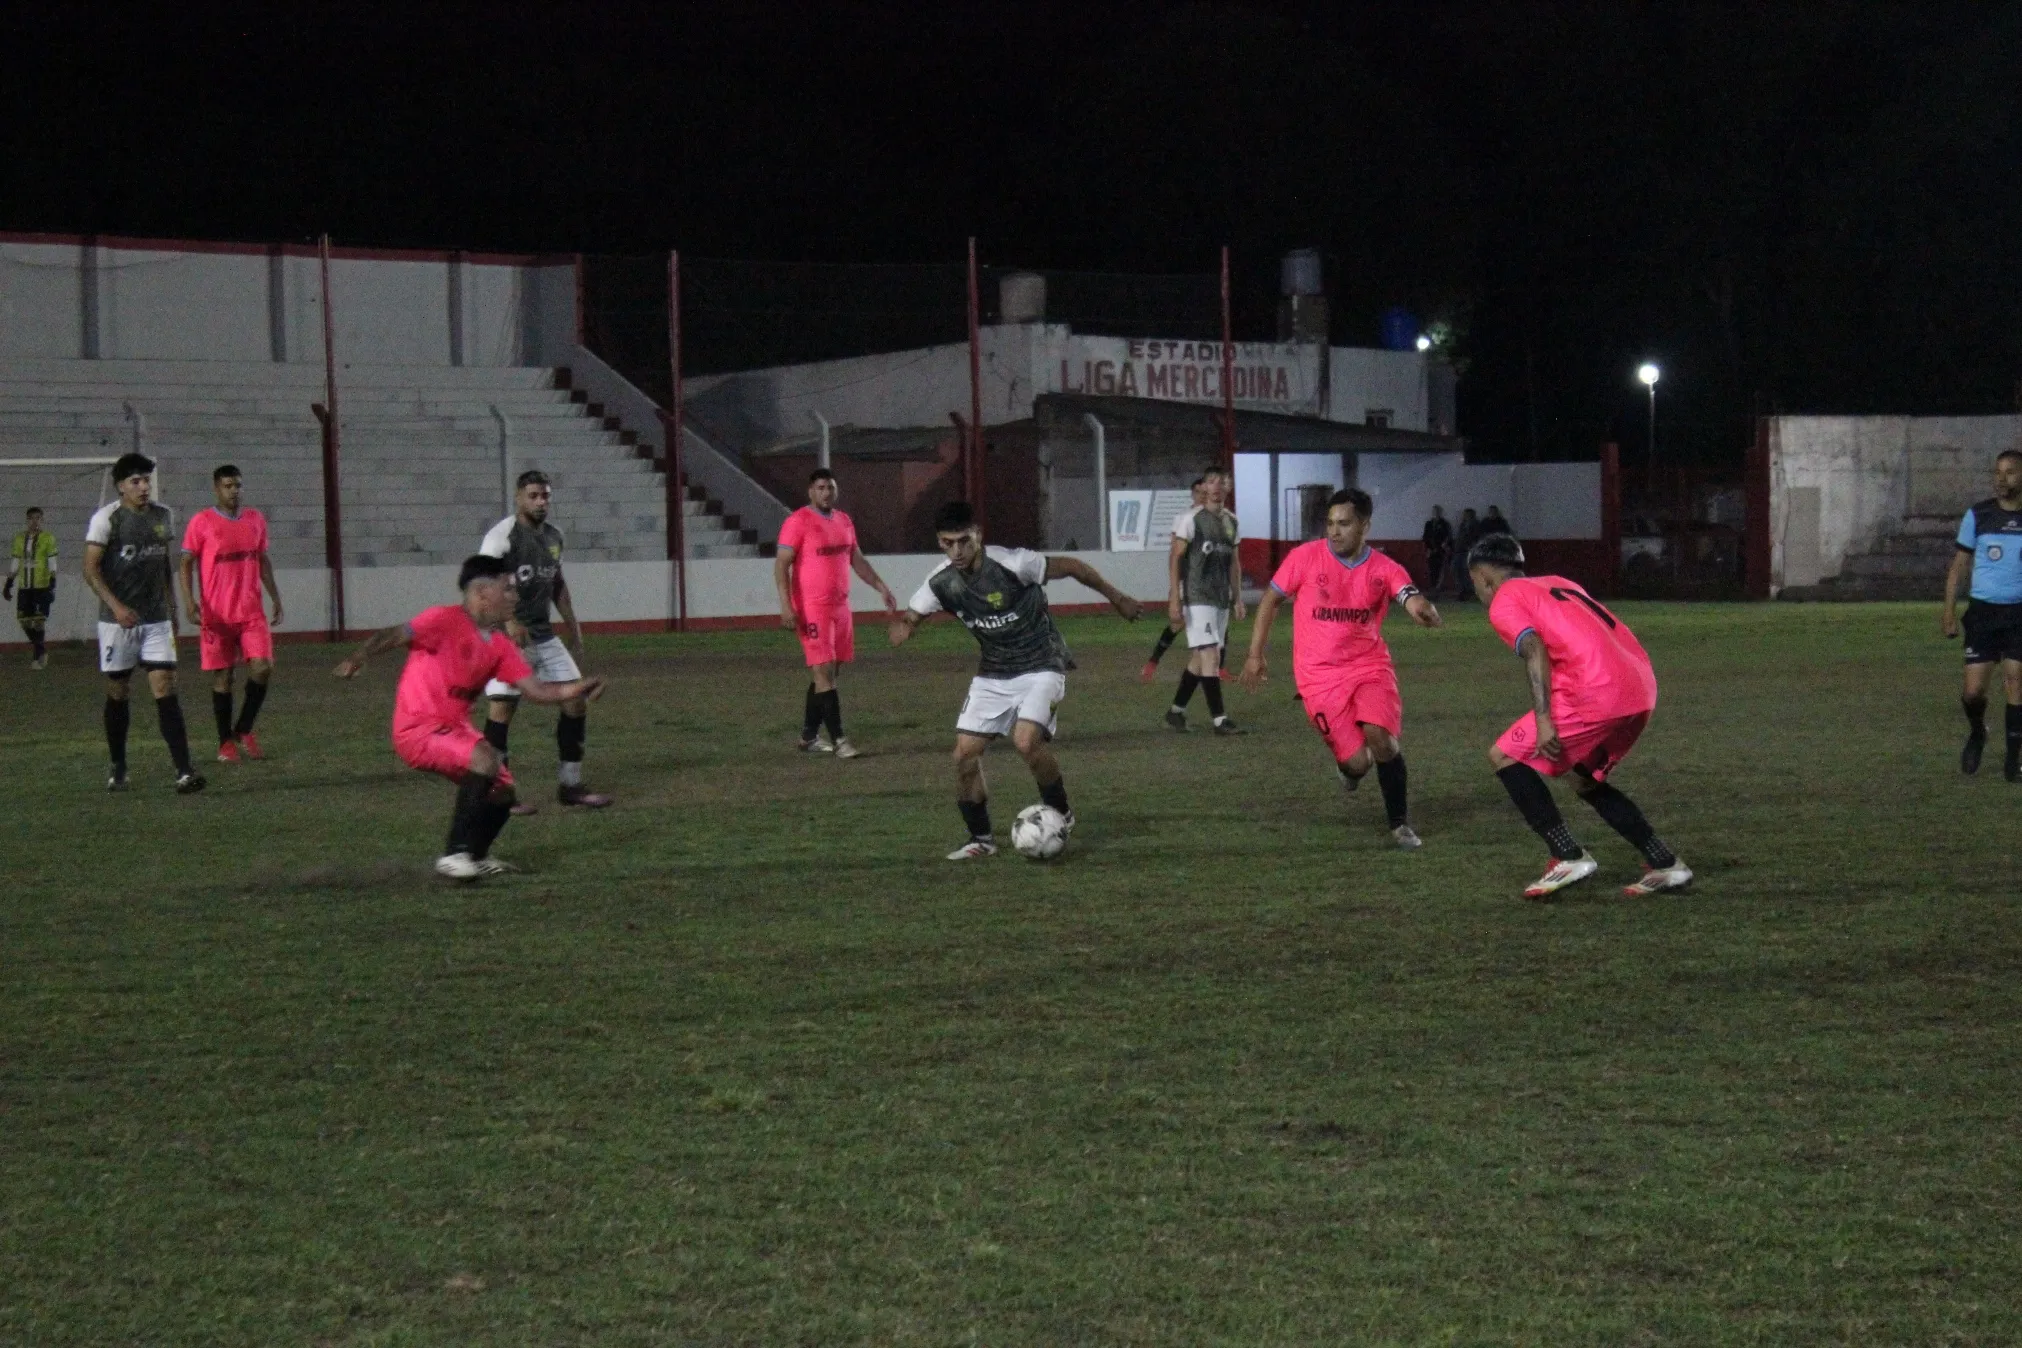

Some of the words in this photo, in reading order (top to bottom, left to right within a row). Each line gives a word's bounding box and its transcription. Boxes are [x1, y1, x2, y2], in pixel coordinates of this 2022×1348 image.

[1060, 359, 1140, 396] LIGA
[1550, 587, 1616, 629] 7
[106, 645, 113, 663] 2
